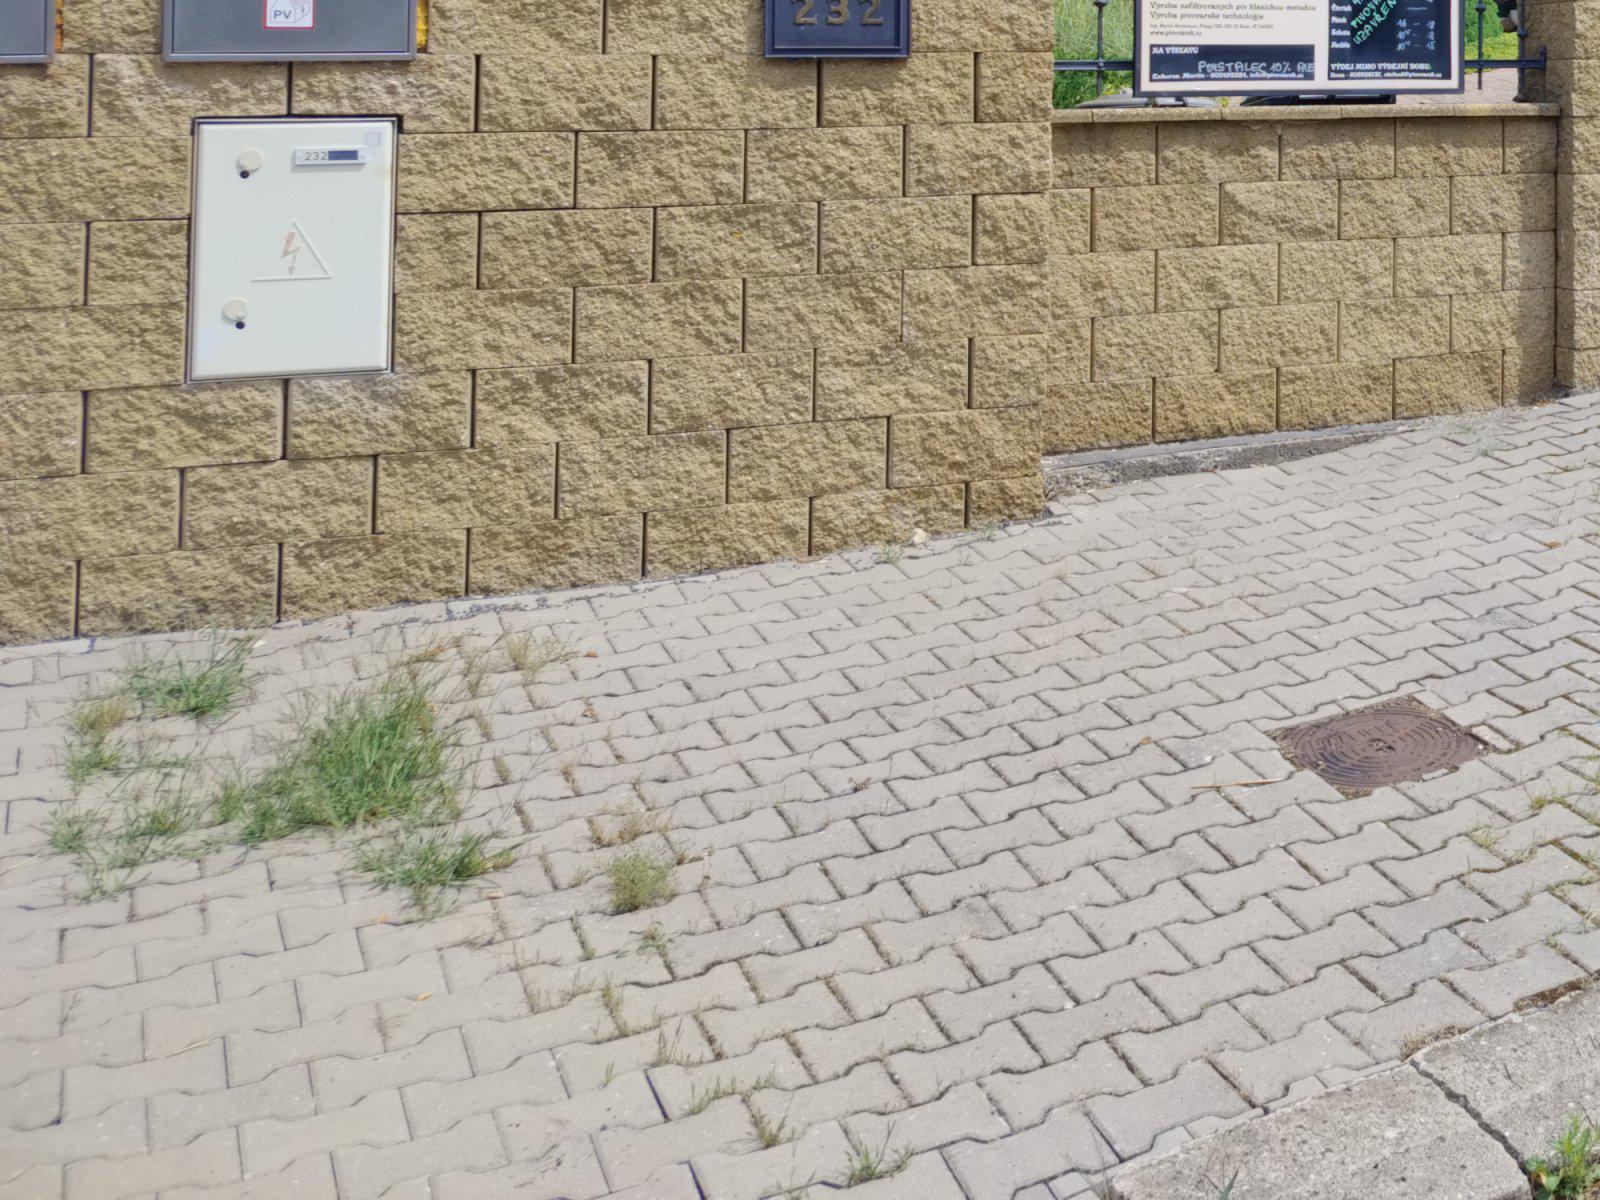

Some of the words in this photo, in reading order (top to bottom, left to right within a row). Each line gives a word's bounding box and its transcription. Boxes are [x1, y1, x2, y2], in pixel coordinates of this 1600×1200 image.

[1286, 4, 1317, 12] metodou
[273, 9, 292, 20] PV
[1222, 12, 1265, 22] technologie
[1152, 47, 1164, 55] NA
[304, 151, 328, 161] 232
